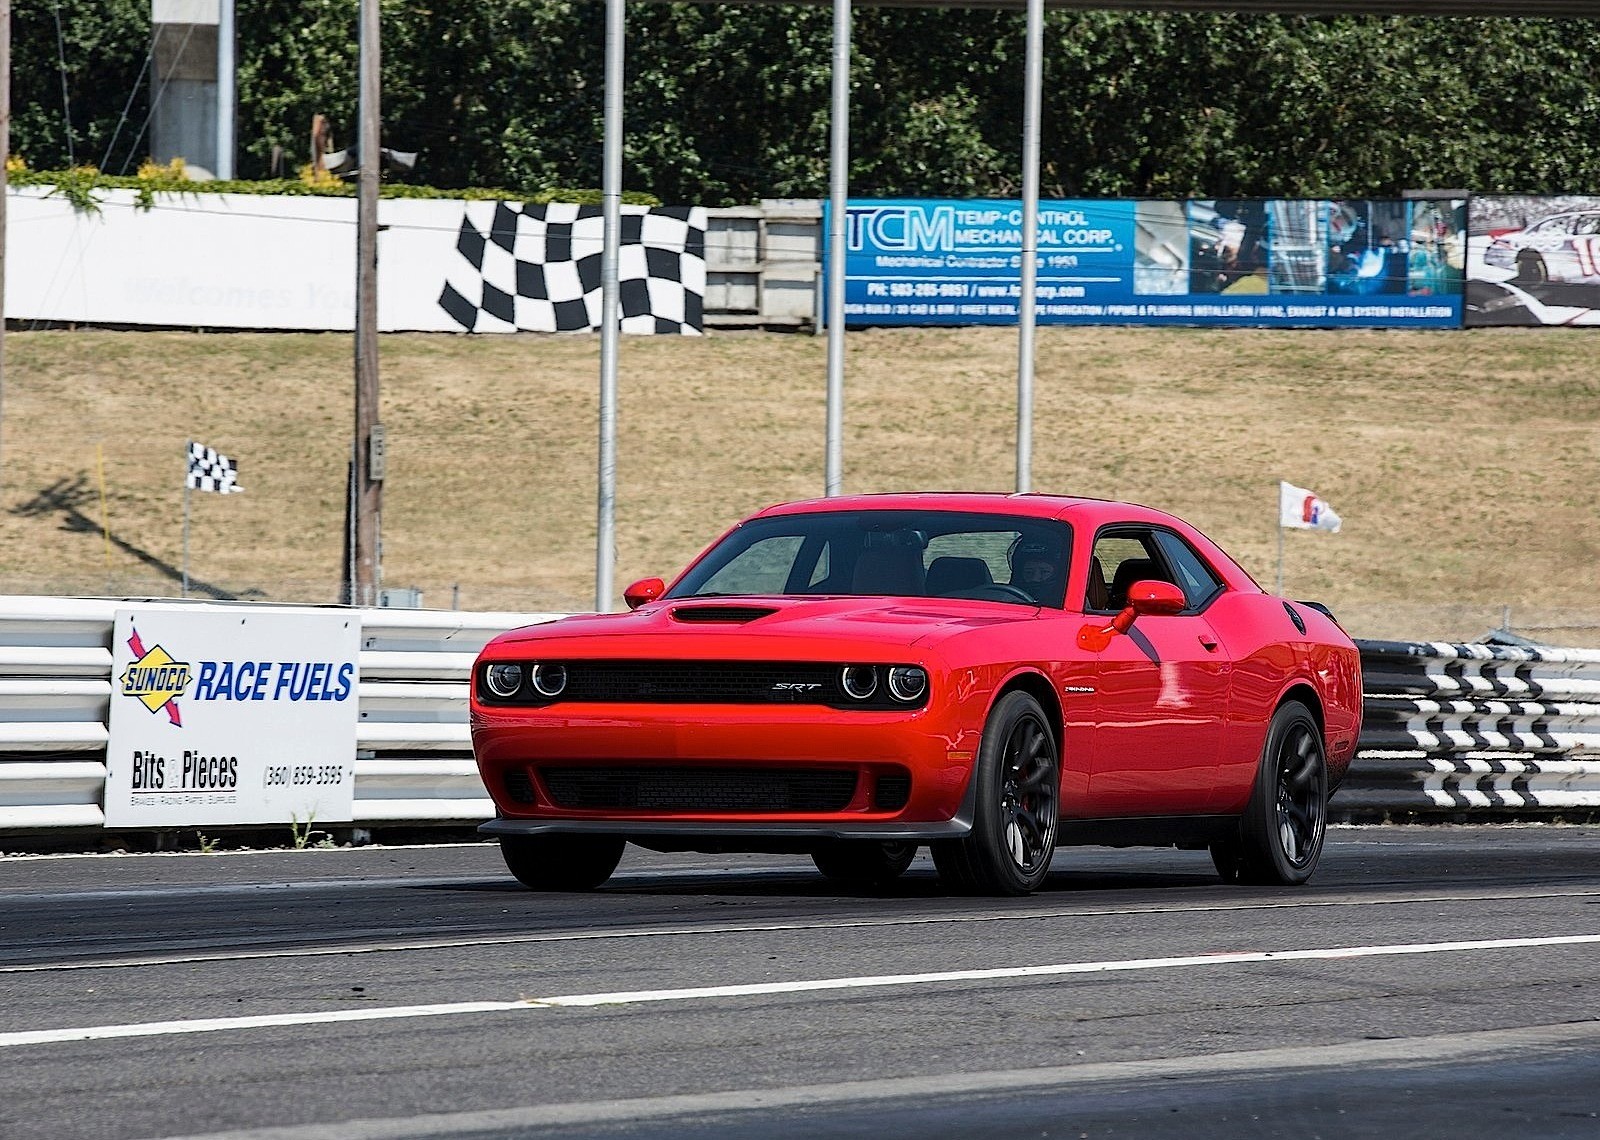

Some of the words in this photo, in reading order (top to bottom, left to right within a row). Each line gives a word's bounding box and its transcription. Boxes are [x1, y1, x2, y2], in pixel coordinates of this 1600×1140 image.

[845, 206, 954, 251] TCM
[1063, 230, 1115, 244] CORP.
[875, 255, 944, 268] Mechanical
[125, 667, 188, 691] SUNOCO
[194, 661, 273, 701] RACE
[273, 662, 354, 702] FUELS
[772, 682, 822, 693] SRT
[132, 750, 165, 789] Bits
[182, 750, 237, 789] Pieces
[263, 765, 291, 789] (360)
